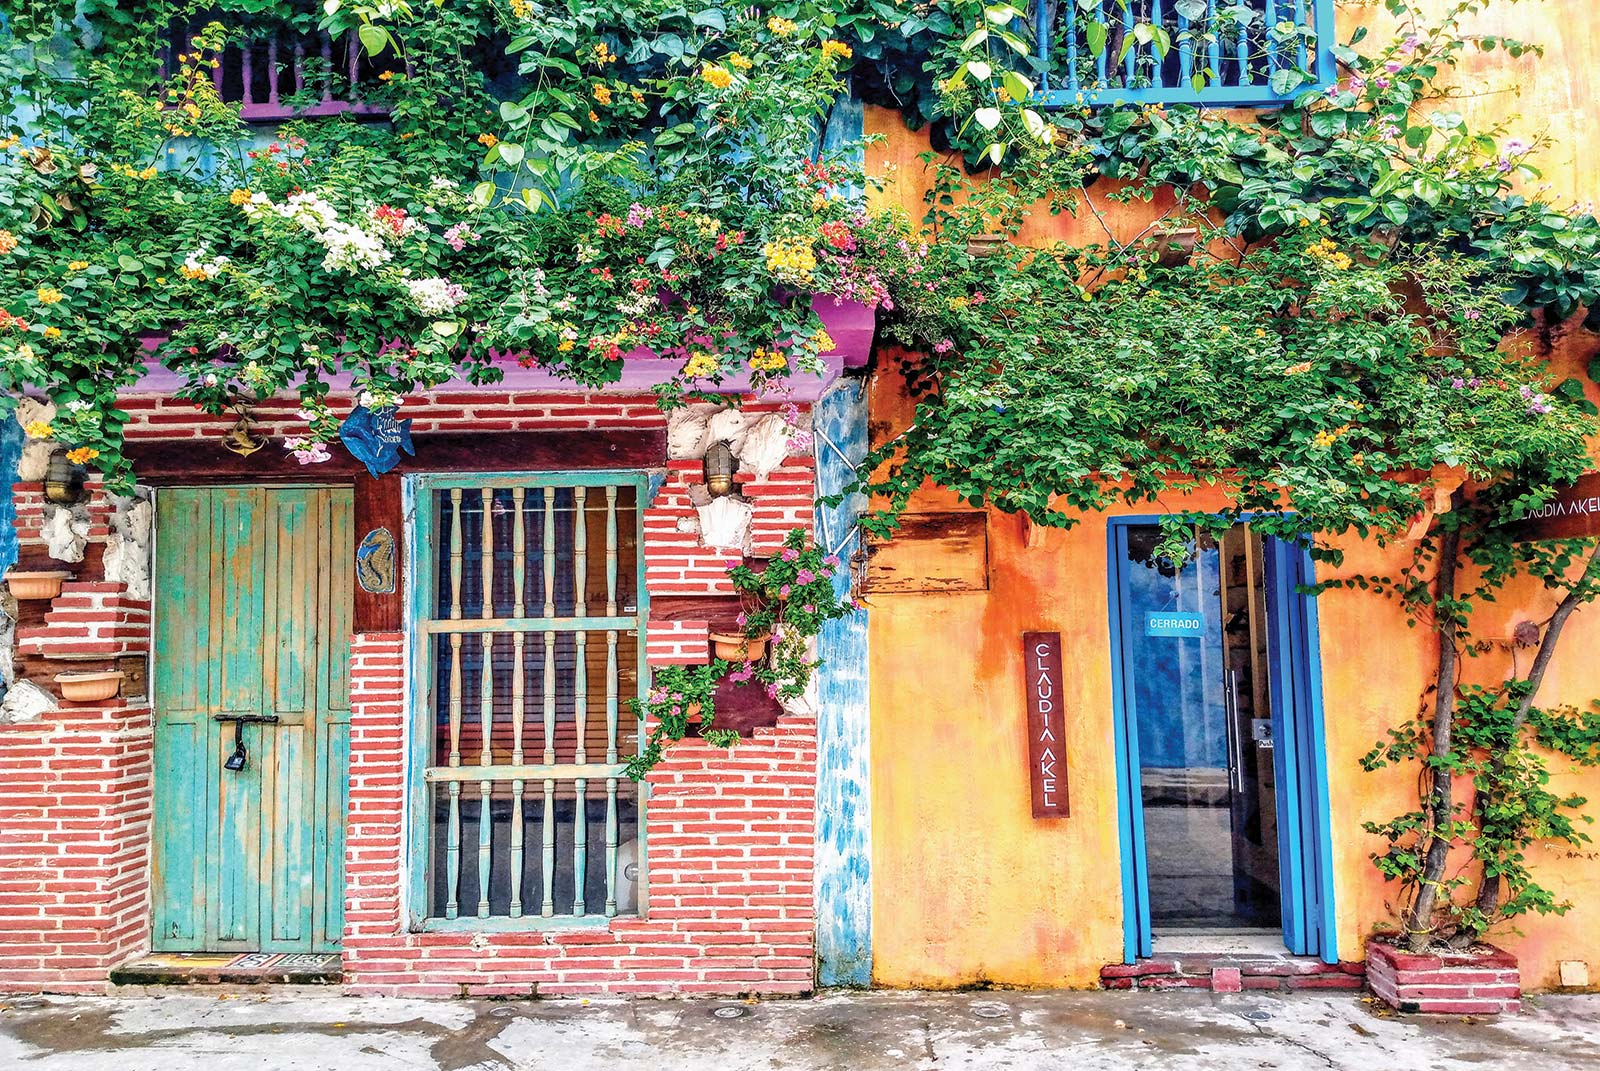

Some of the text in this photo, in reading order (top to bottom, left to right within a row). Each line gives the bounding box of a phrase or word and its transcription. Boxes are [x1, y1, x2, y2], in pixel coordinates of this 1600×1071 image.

[1149, 618, 1200, 630] CERRADO
[1036, 643, 1057, 807] CLAUDIA AKEL
